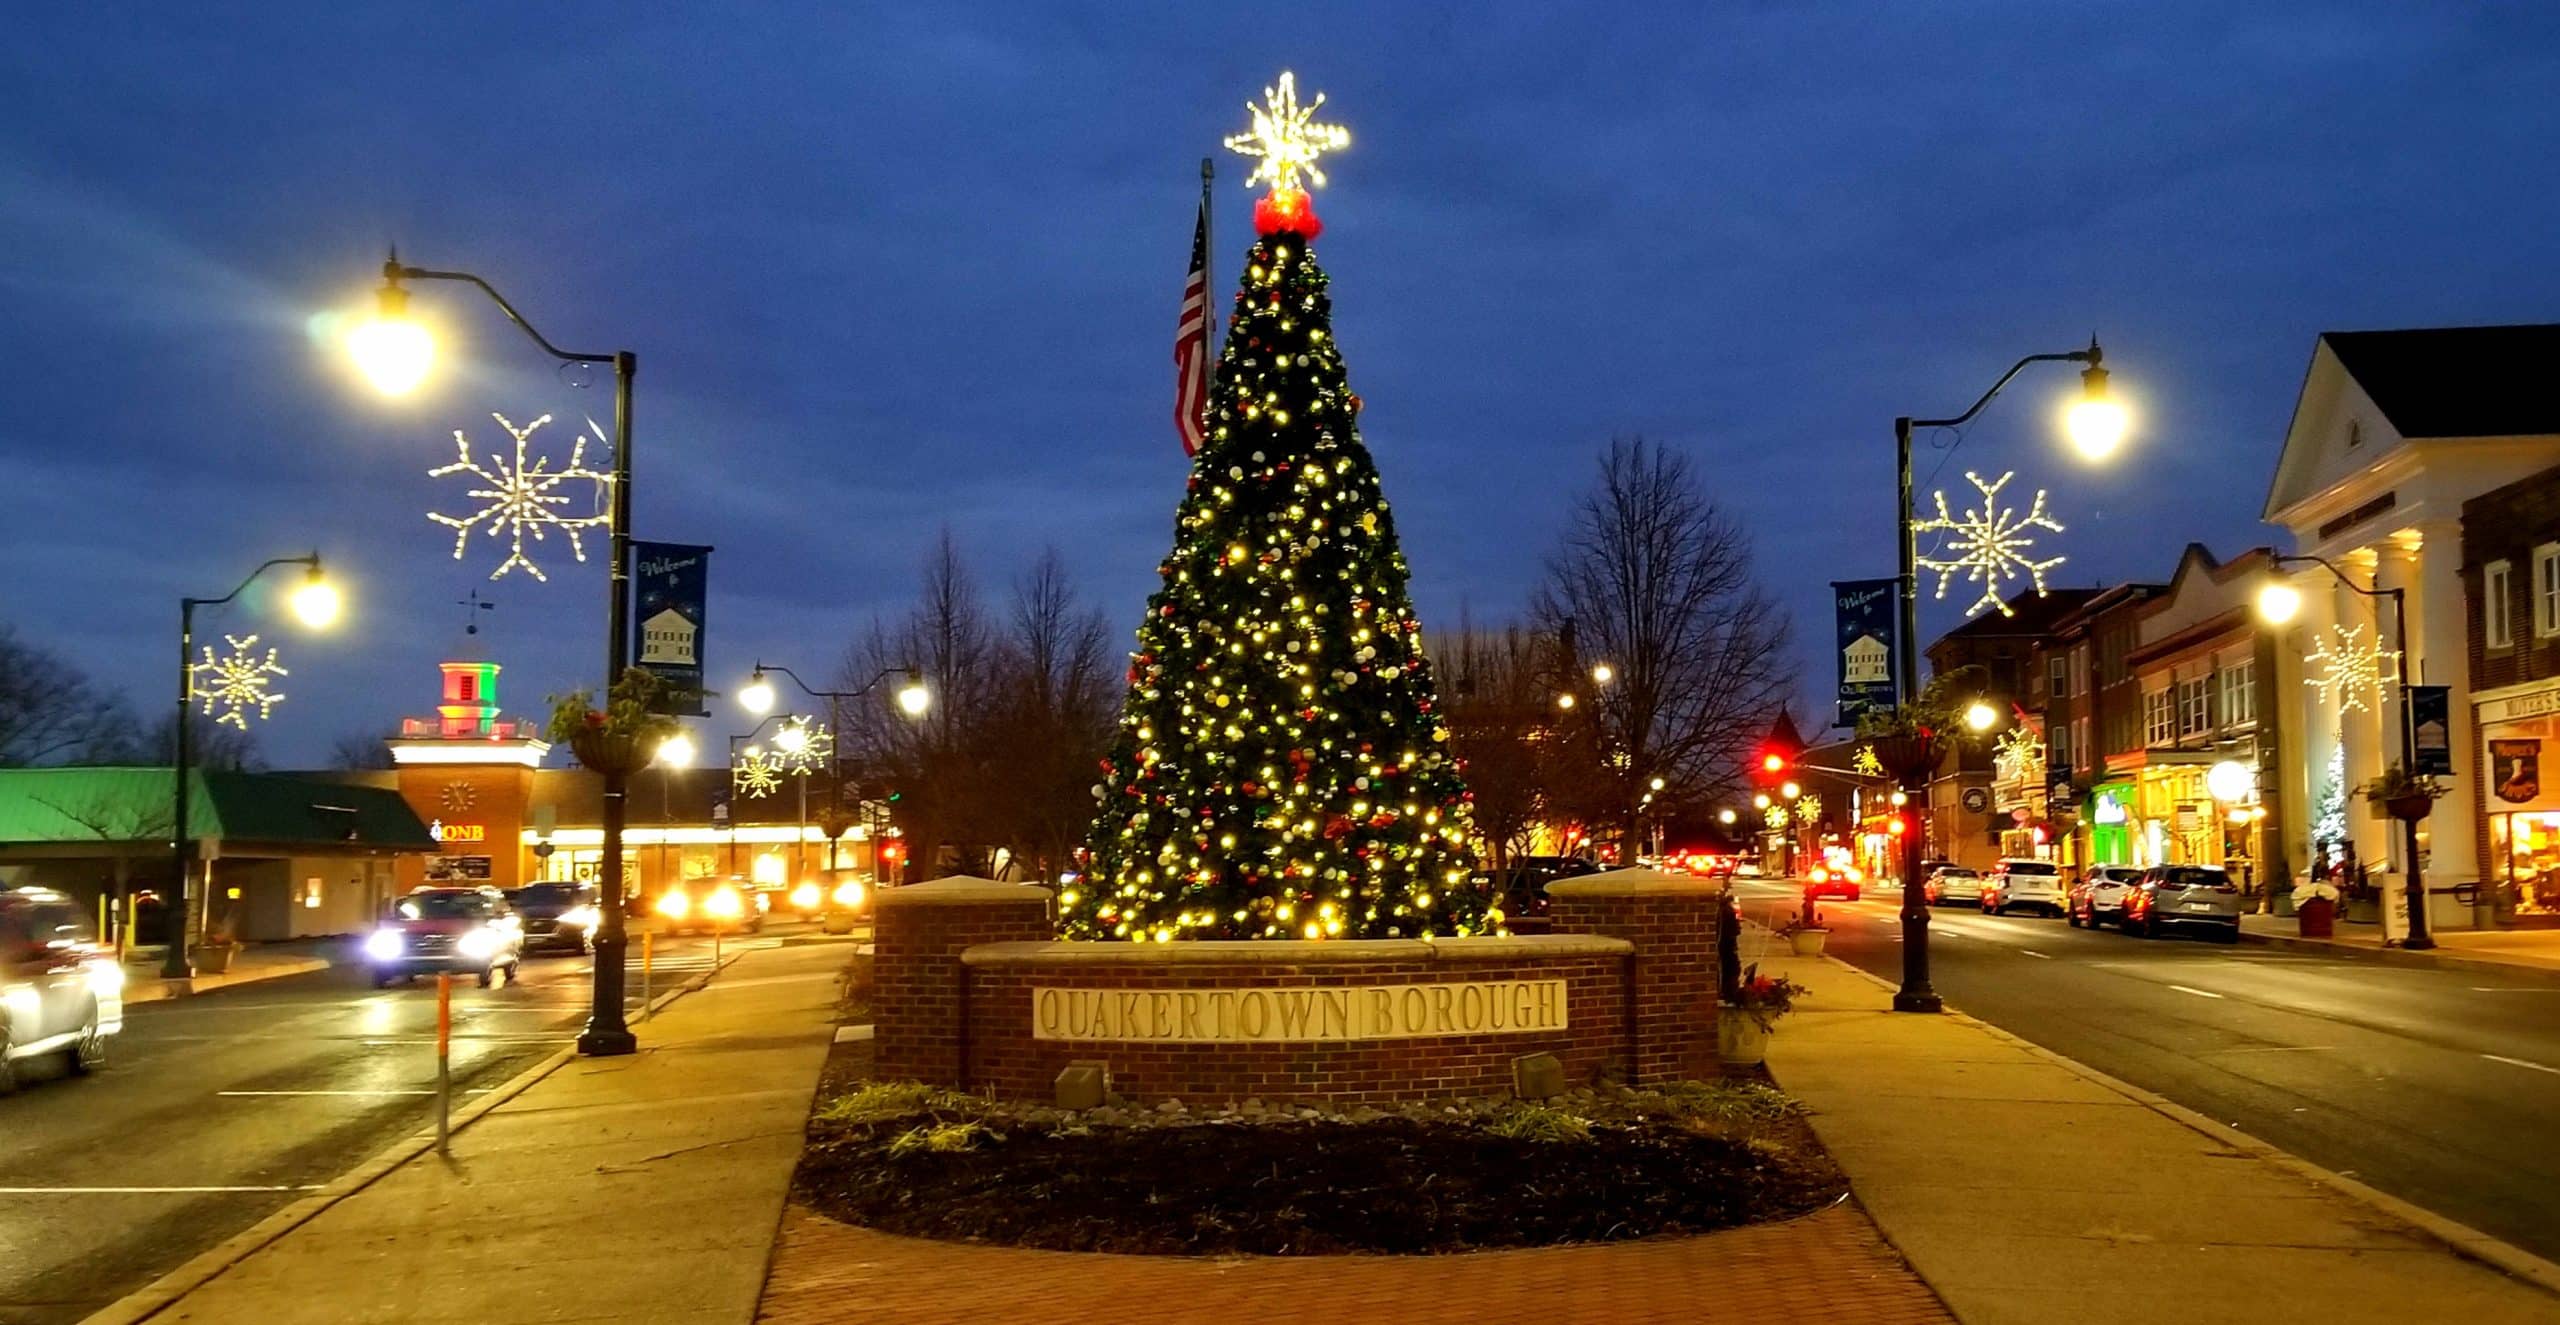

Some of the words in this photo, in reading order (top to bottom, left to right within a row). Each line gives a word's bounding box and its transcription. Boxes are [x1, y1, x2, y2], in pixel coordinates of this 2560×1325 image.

[639, 556, 696, 577] Welcome
[1838, 588, 1885, 610] Welcome
[1039, 989, 1351, 1038] QUAKERTOWN
[1367, 982, 1559, 1036] BOROUGH
